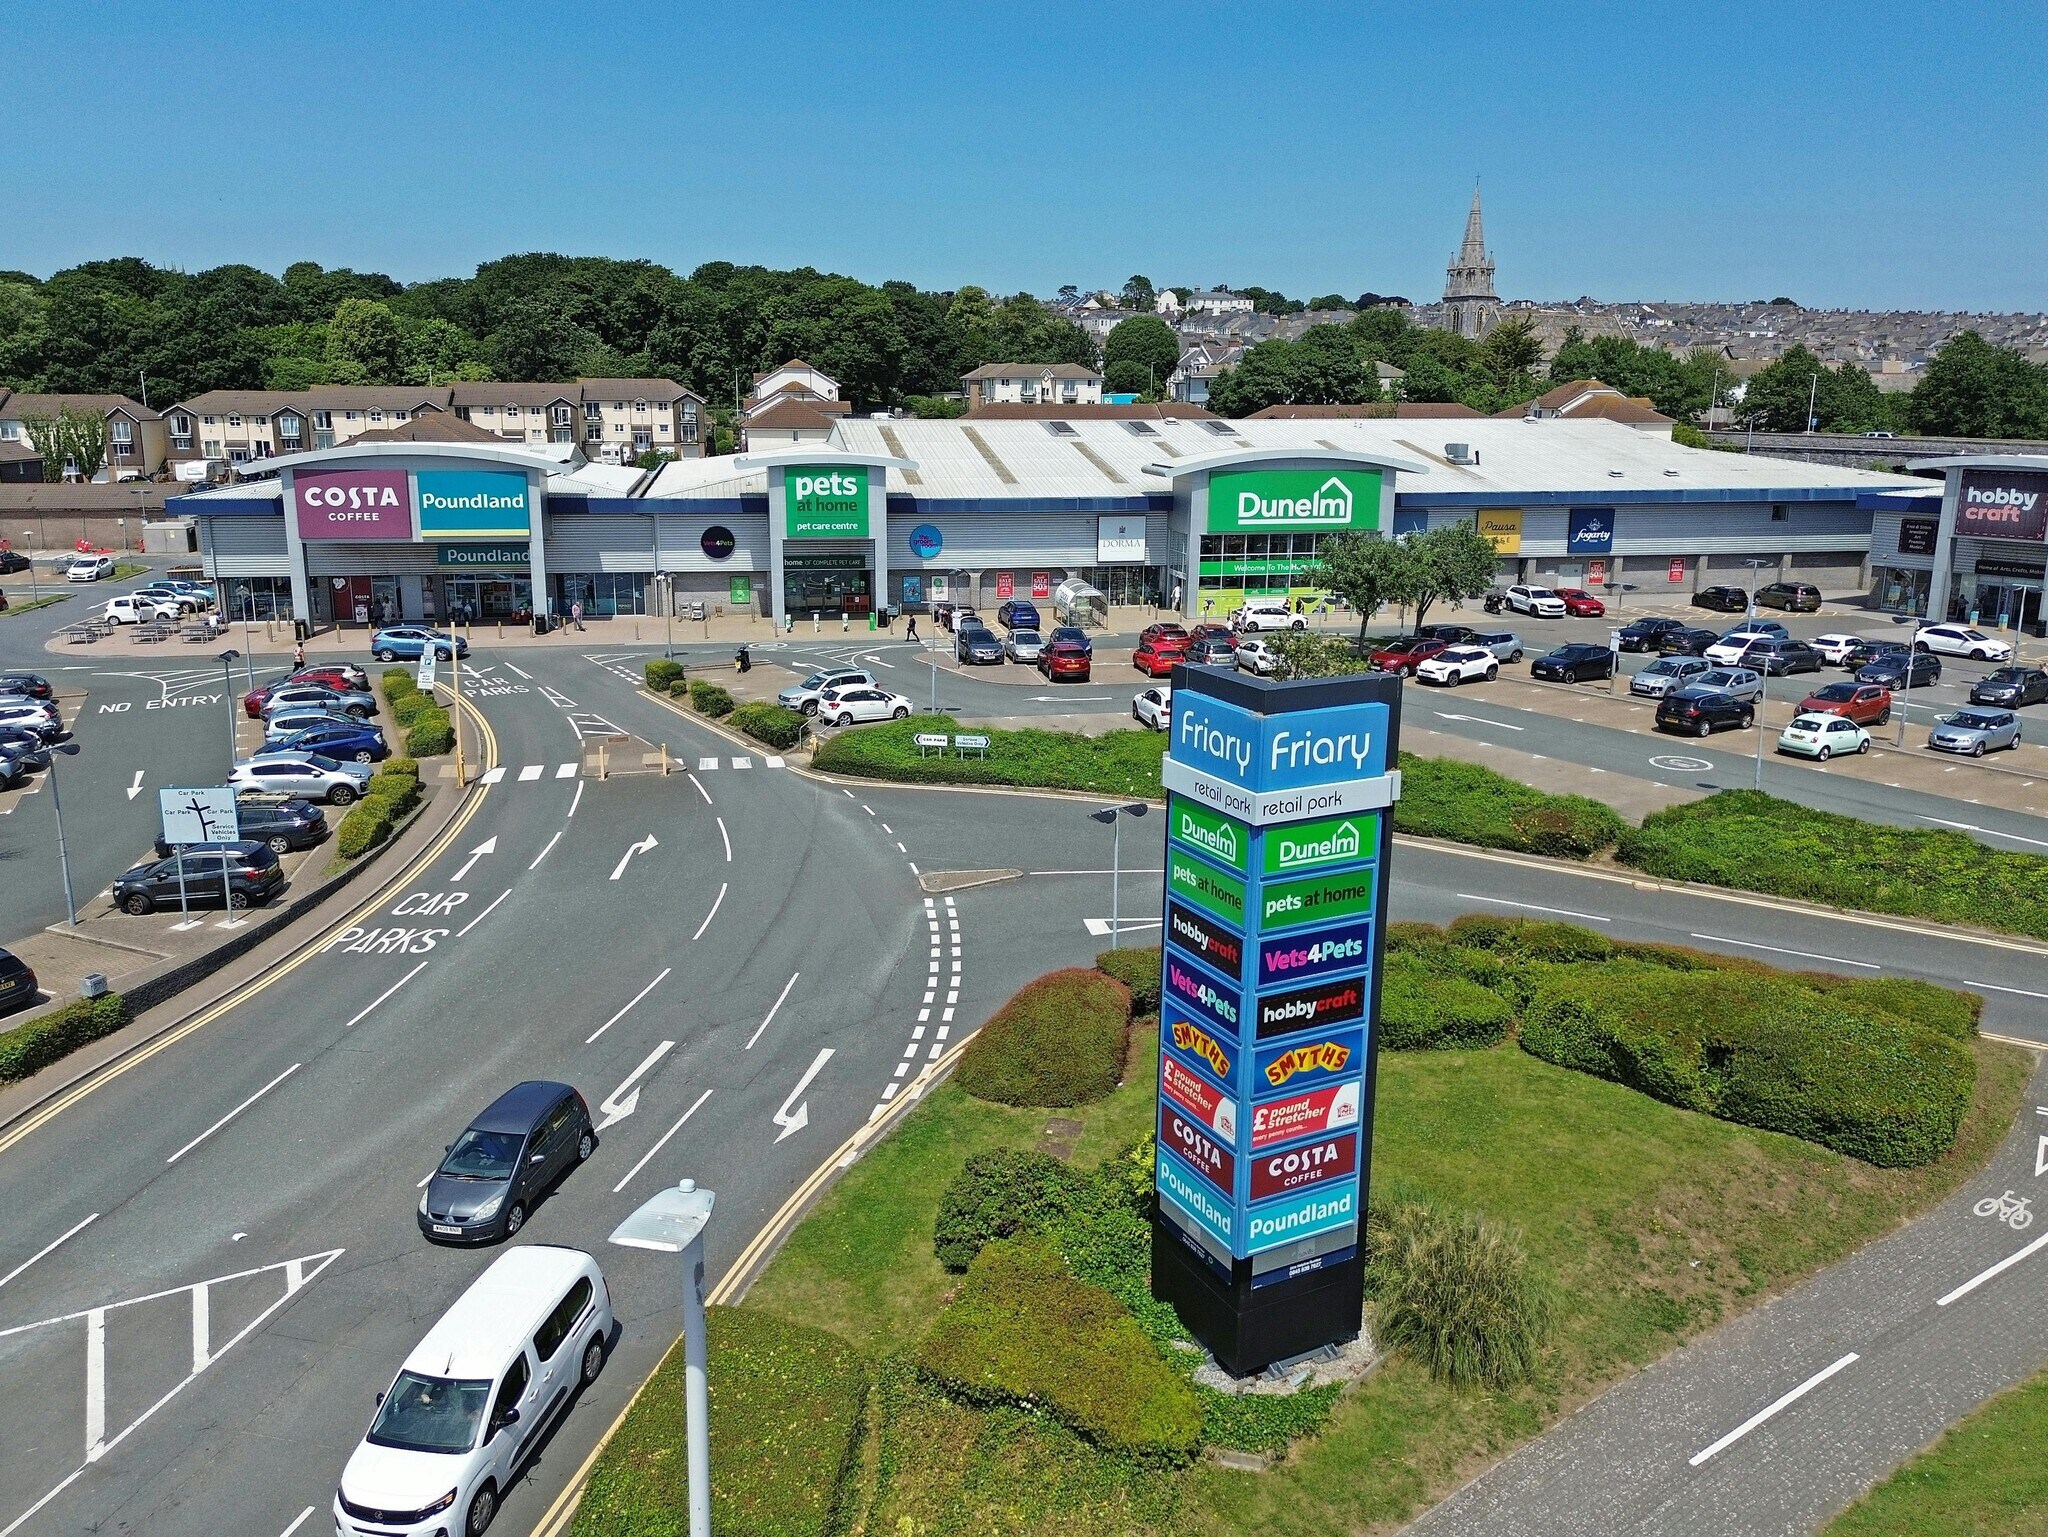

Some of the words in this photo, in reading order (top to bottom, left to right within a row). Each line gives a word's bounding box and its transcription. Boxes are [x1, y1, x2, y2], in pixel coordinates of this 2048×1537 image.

[304, 486, 399, 510] COSTA
[796, 472, 858, 500] pets
[1967, 487, 2038, 511] hobby
[422, 493, 524, 509] Poundland
[797, 499, 812, 512] at
[816, 497, 858, 512] home
[1238, 484, 1349, 521] Dunelm
[1965, 504, 2021, 523] craft
[328, 512, 380, 521] COFFEE
[797, 523, 811, 532] pet
[1482, 521, 1516, 531] Pausa
[1103, 539, 1141, 548] DORMA
[1572, 528, 1611, 542] fogarty
[448, 549, 530, 562] Poundland
[784, 558, 803, 566] home
[1277, 563, 1289, 571] The
[463, 684, 530, 698] PARKS
[464, 677, 510, 688] CAR
[99, 702, 131, 714] NO
[145, 693, 223, 710] ENTRY
[1181, 710, 1251, 777] Friary
[1271, 730, 1370, 771] Friary
[1194, 781, 1222, 803] retail
[1224, 794, 1251, 815] park
[1262, 796, 1302, 817] retail
[1307, 790, 1343, 815] park
[1182, 813, 1236, 858] Dunelm
[1278, 828, 1357, 863] Dunelm
[1173, 864, 1197, 887] pets
[1197, 877, 1210, 894] at
[1211, 878, 1242, 911] home
[391, 892, 470, 916] CAR
[1266, 894, 1301, 918] pets
[1304, 890, 1320, 908] at
[1323, 885, 1366, 905] home
[320, 927, 450, 954] PARKS
[1173, 913, 1238, 965] hobbycraft
[1265, 937, 1363, 973] Vets4Pets
[1170, 964, 1237, 1023] Vets4Pets
[1263, 989, 1357, 1023] hobbycraft
[1173, 1024, 1229, 1077] SMYTHS
[1267, 1045, 1348, 1083] SMYTHS
[1174, 1069, 1202, 1092] pound
[1173, 1078, 1213, 1111] stretcher
[1269, 1098, 1311, 1118] pound
[1267, 1107, 1326, 1129] stretcher
[1173, 1118, 1222, 1169] COSTA
[1252, 1133, 1268, 1142] every
[1268, 1129, 1285, 1142] penny
[1183, 1147, 1210, 1174] COFFEE
[1268, 1143, 1338, 1177] COSTA
[1284, 1168, 1323, 1186] COFFEE
[1161, 1161, 1231, 1235] Poundland
[1250, 1193, 1351, 1239] Poundland
